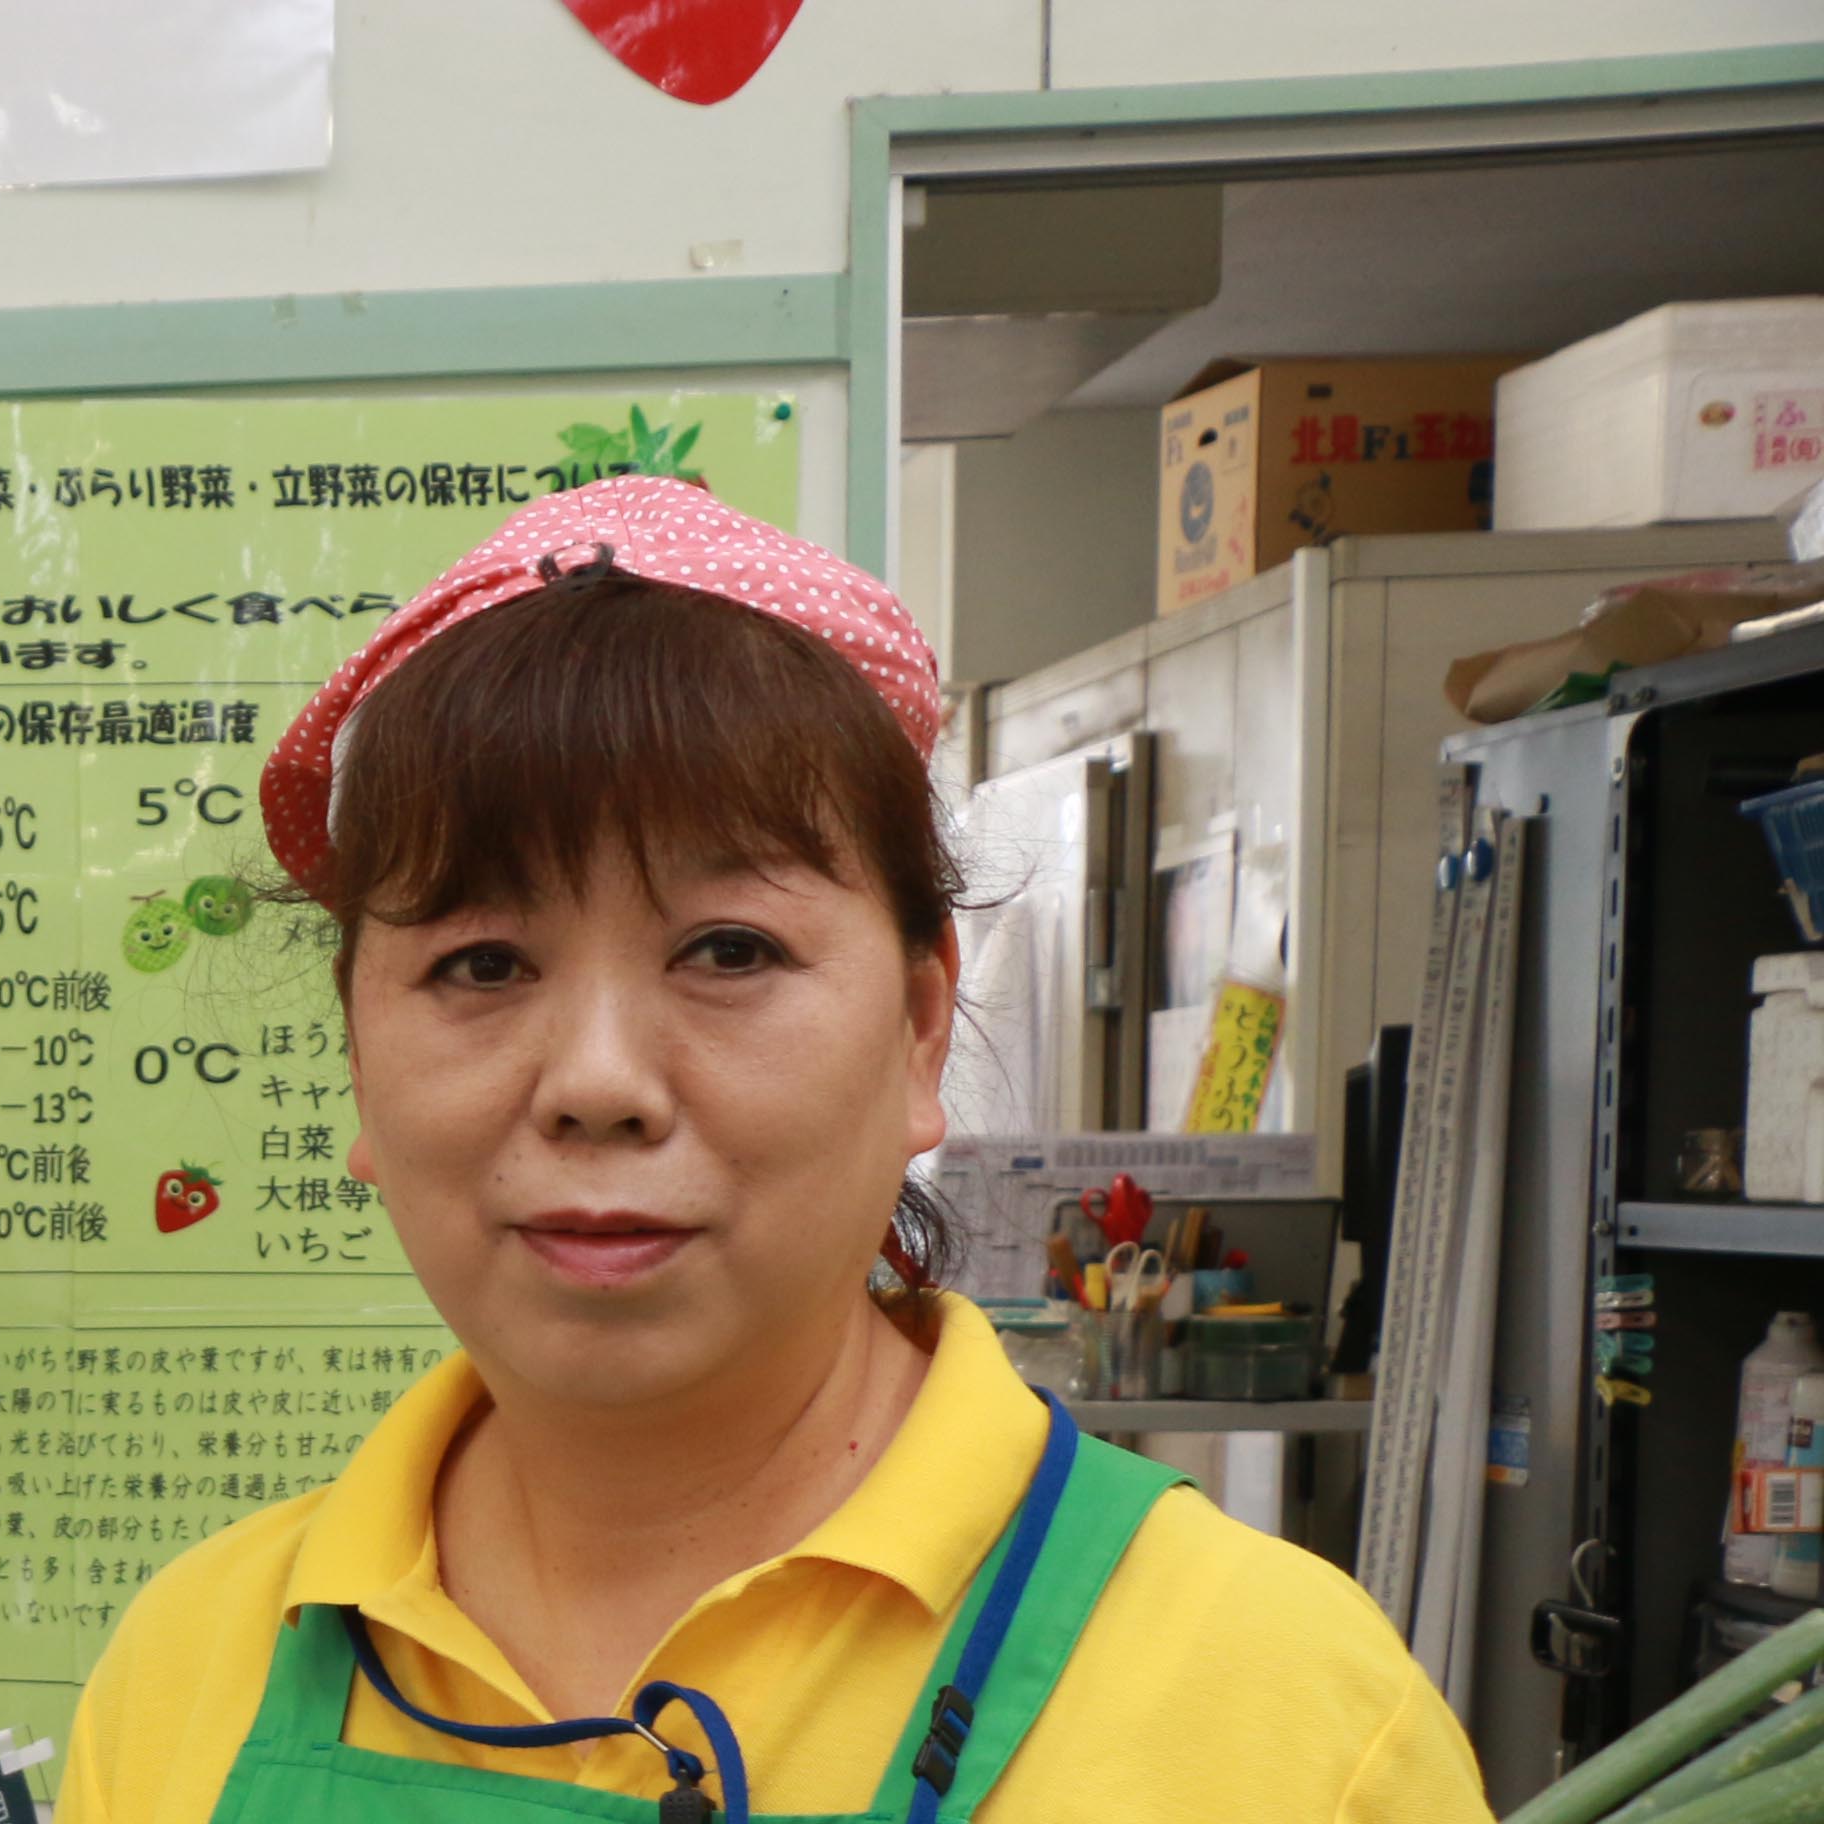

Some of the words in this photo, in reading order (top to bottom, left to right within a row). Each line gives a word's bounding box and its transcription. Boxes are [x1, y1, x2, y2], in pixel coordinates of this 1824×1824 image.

[260, 1124, 334, 1162] 白菜
[255, 1176, 387, 1213] 大根等
[255, 1228, 373, 1262] いちご
